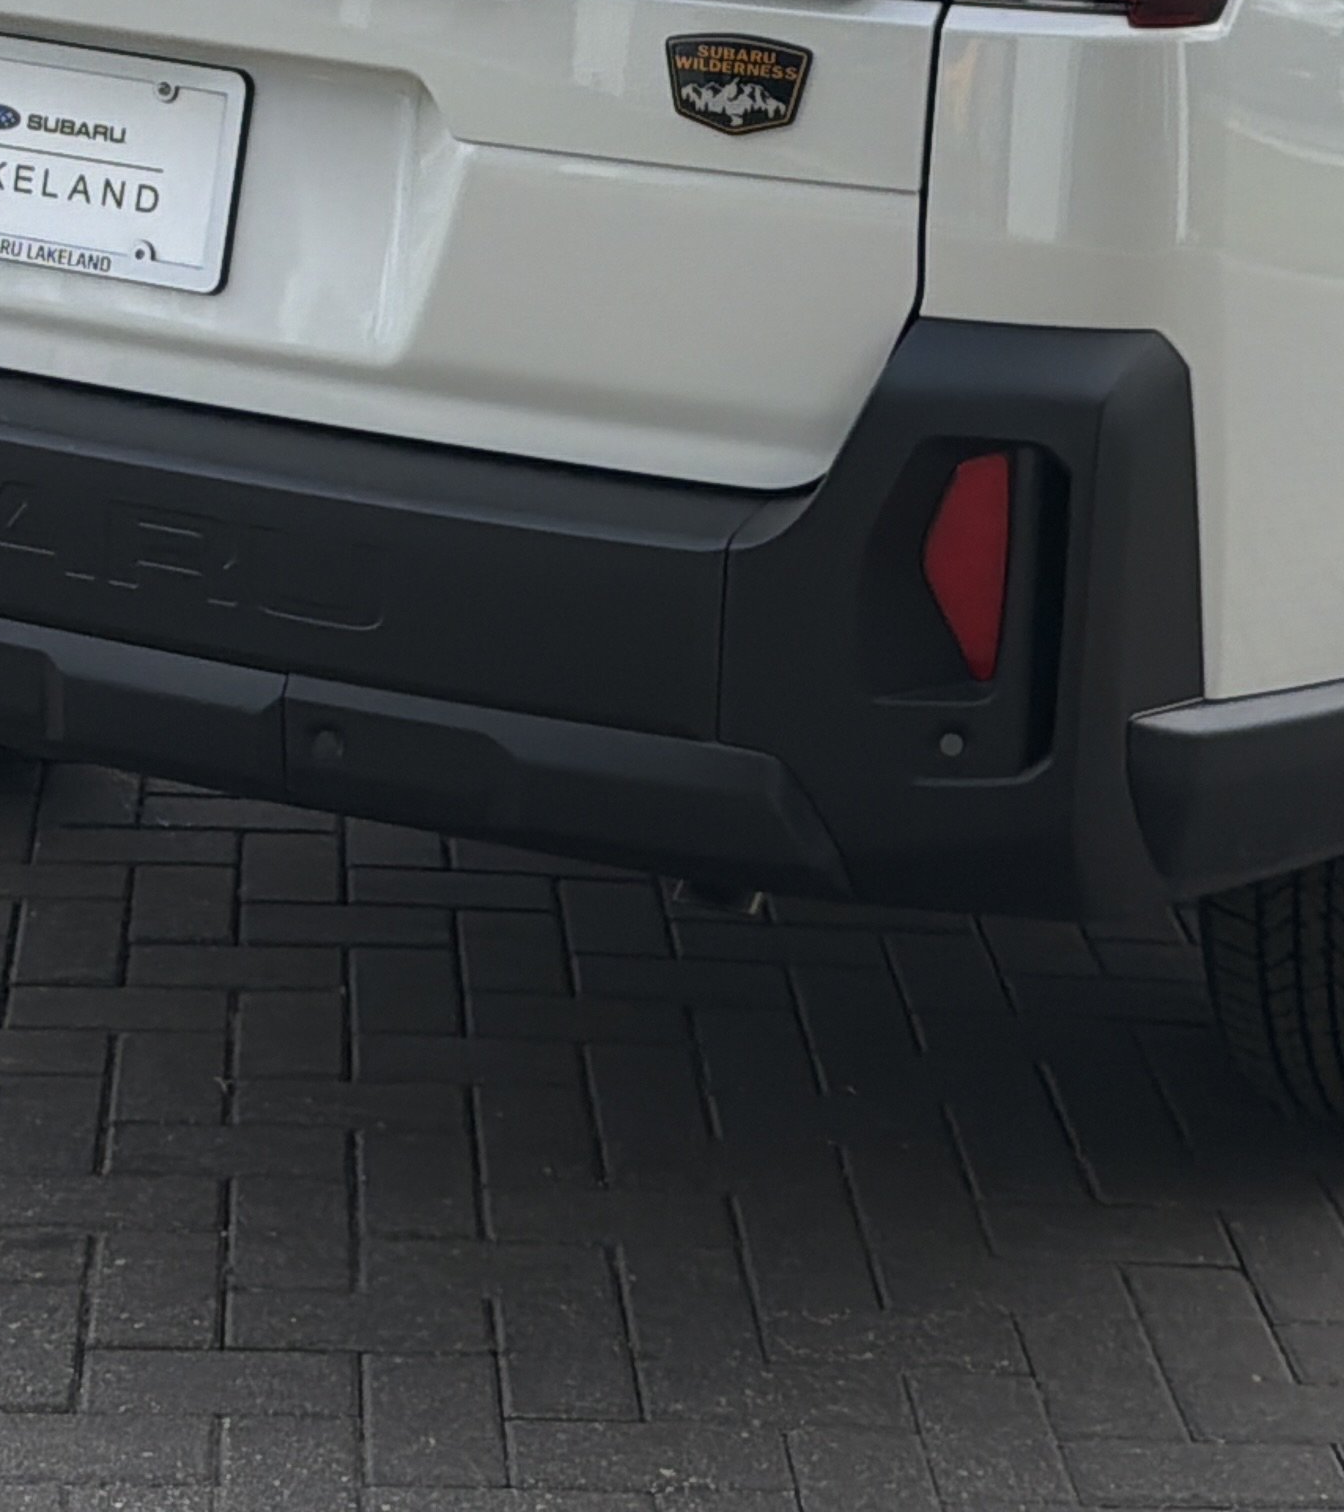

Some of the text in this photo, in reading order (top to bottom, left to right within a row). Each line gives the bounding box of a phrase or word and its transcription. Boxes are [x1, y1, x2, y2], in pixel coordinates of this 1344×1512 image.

[674, 54, 799, 81] WILDERNESS
[697, 44, 777, 65] SUBARU
[25, 112, 128, 145] SUBARU
[25, 243, 112, 274] LAKELAND
